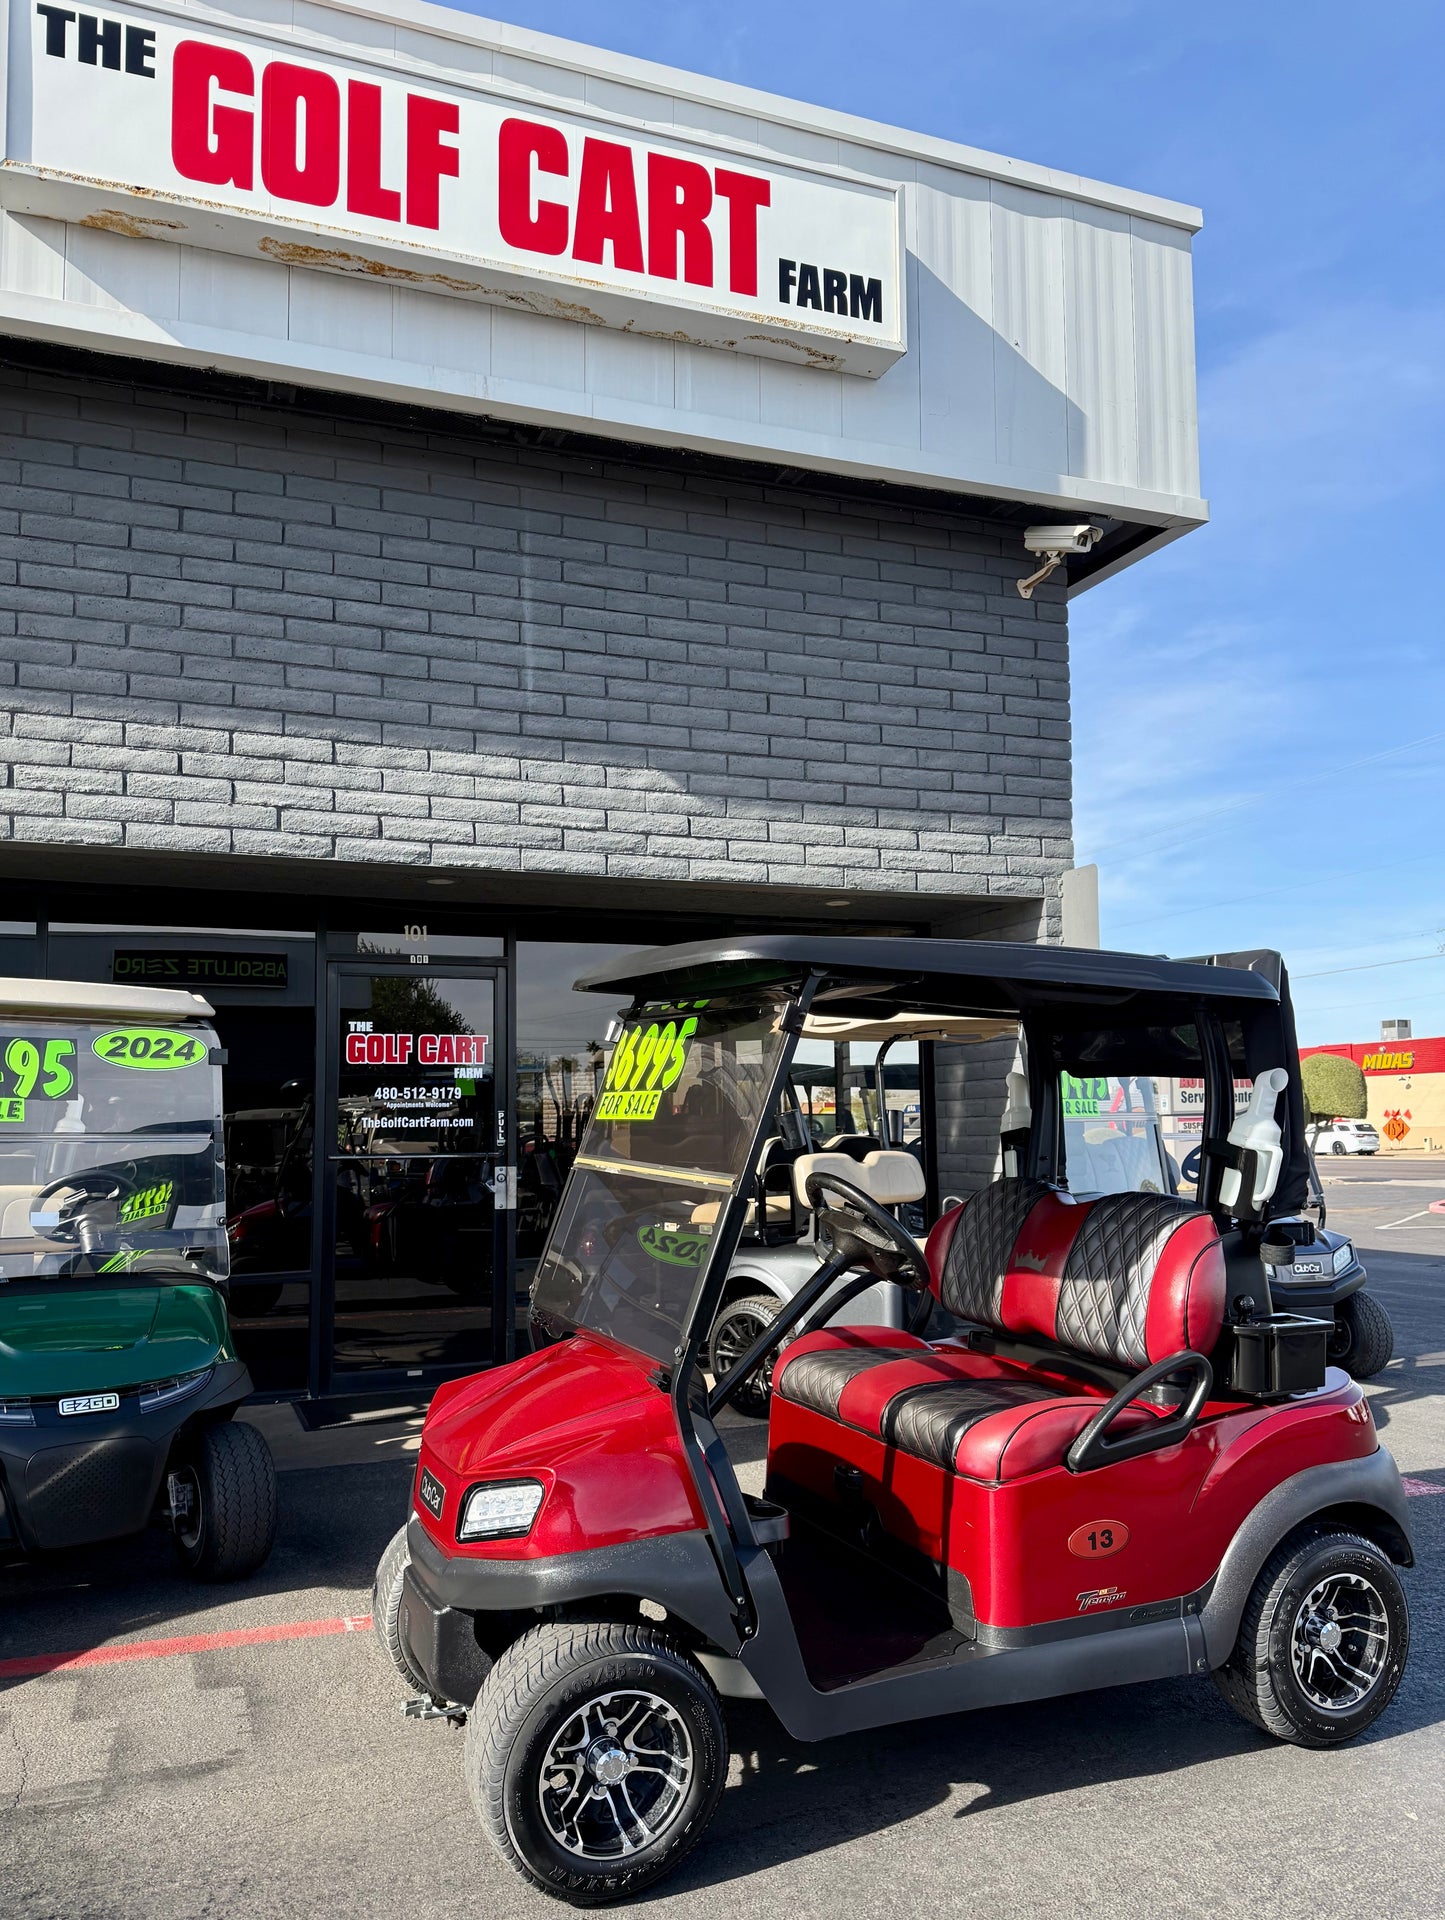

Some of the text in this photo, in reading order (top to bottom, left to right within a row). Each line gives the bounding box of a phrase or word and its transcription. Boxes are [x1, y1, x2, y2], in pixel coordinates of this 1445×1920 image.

[36, 3, 156, 79] THE
[171, 39, 771, 298] GOLF CART
[778, 258, 883, 323] FARM
[404, 924, 427, 941] 101
[348, 1021, 373, 1032] THE
[105, 1036, 196, 1061] 2024
[346, 1033, 488, 1064] GOLF CART
[605, 1016, 699, 1092] $6995
[0, 1037, 75, 1099] 95
[1362, 1052, 1414, 1071] MIDAS
[454, 1067, 483, 1078] FARM
[374, 1087, 462, 1100] 480-512-9179
[599, 1094, 658, 1114] FOR SALE
[1075, 1101, 1098, 1114] SALE
[361, 1116, 474, 1128] TheGolfCartFarm.com
[1087, 1529, 1114, 1550] 13
[1076, 1589, 1127, 1611] Tempo
